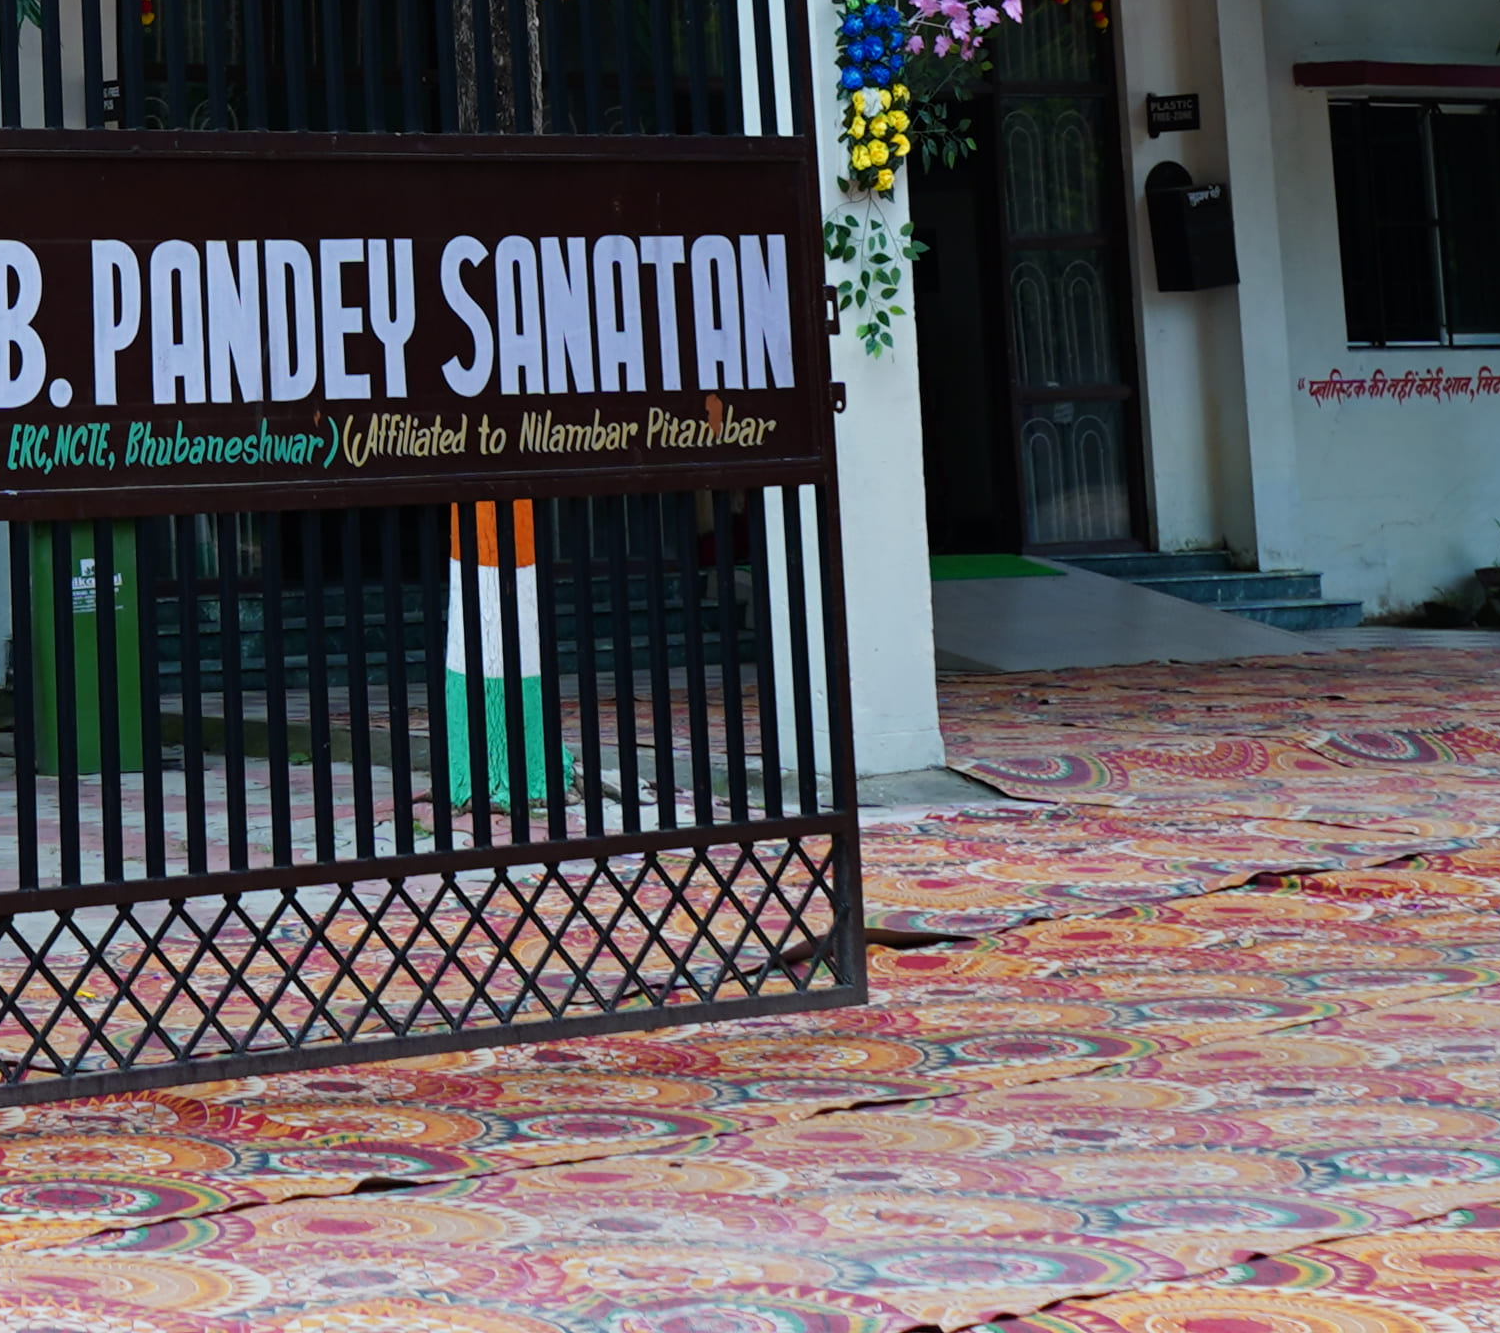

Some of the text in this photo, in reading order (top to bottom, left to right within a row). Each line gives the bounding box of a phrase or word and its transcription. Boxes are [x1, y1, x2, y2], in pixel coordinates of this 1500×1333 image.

[90, 237, 417, 406] PANDEY
[440, 234, 796, 398] SANATAN
[477, 413, 507, 455] to
[519, 408, 639, 454] Nilambar
[645, 404, 777, 451] Pitambar
